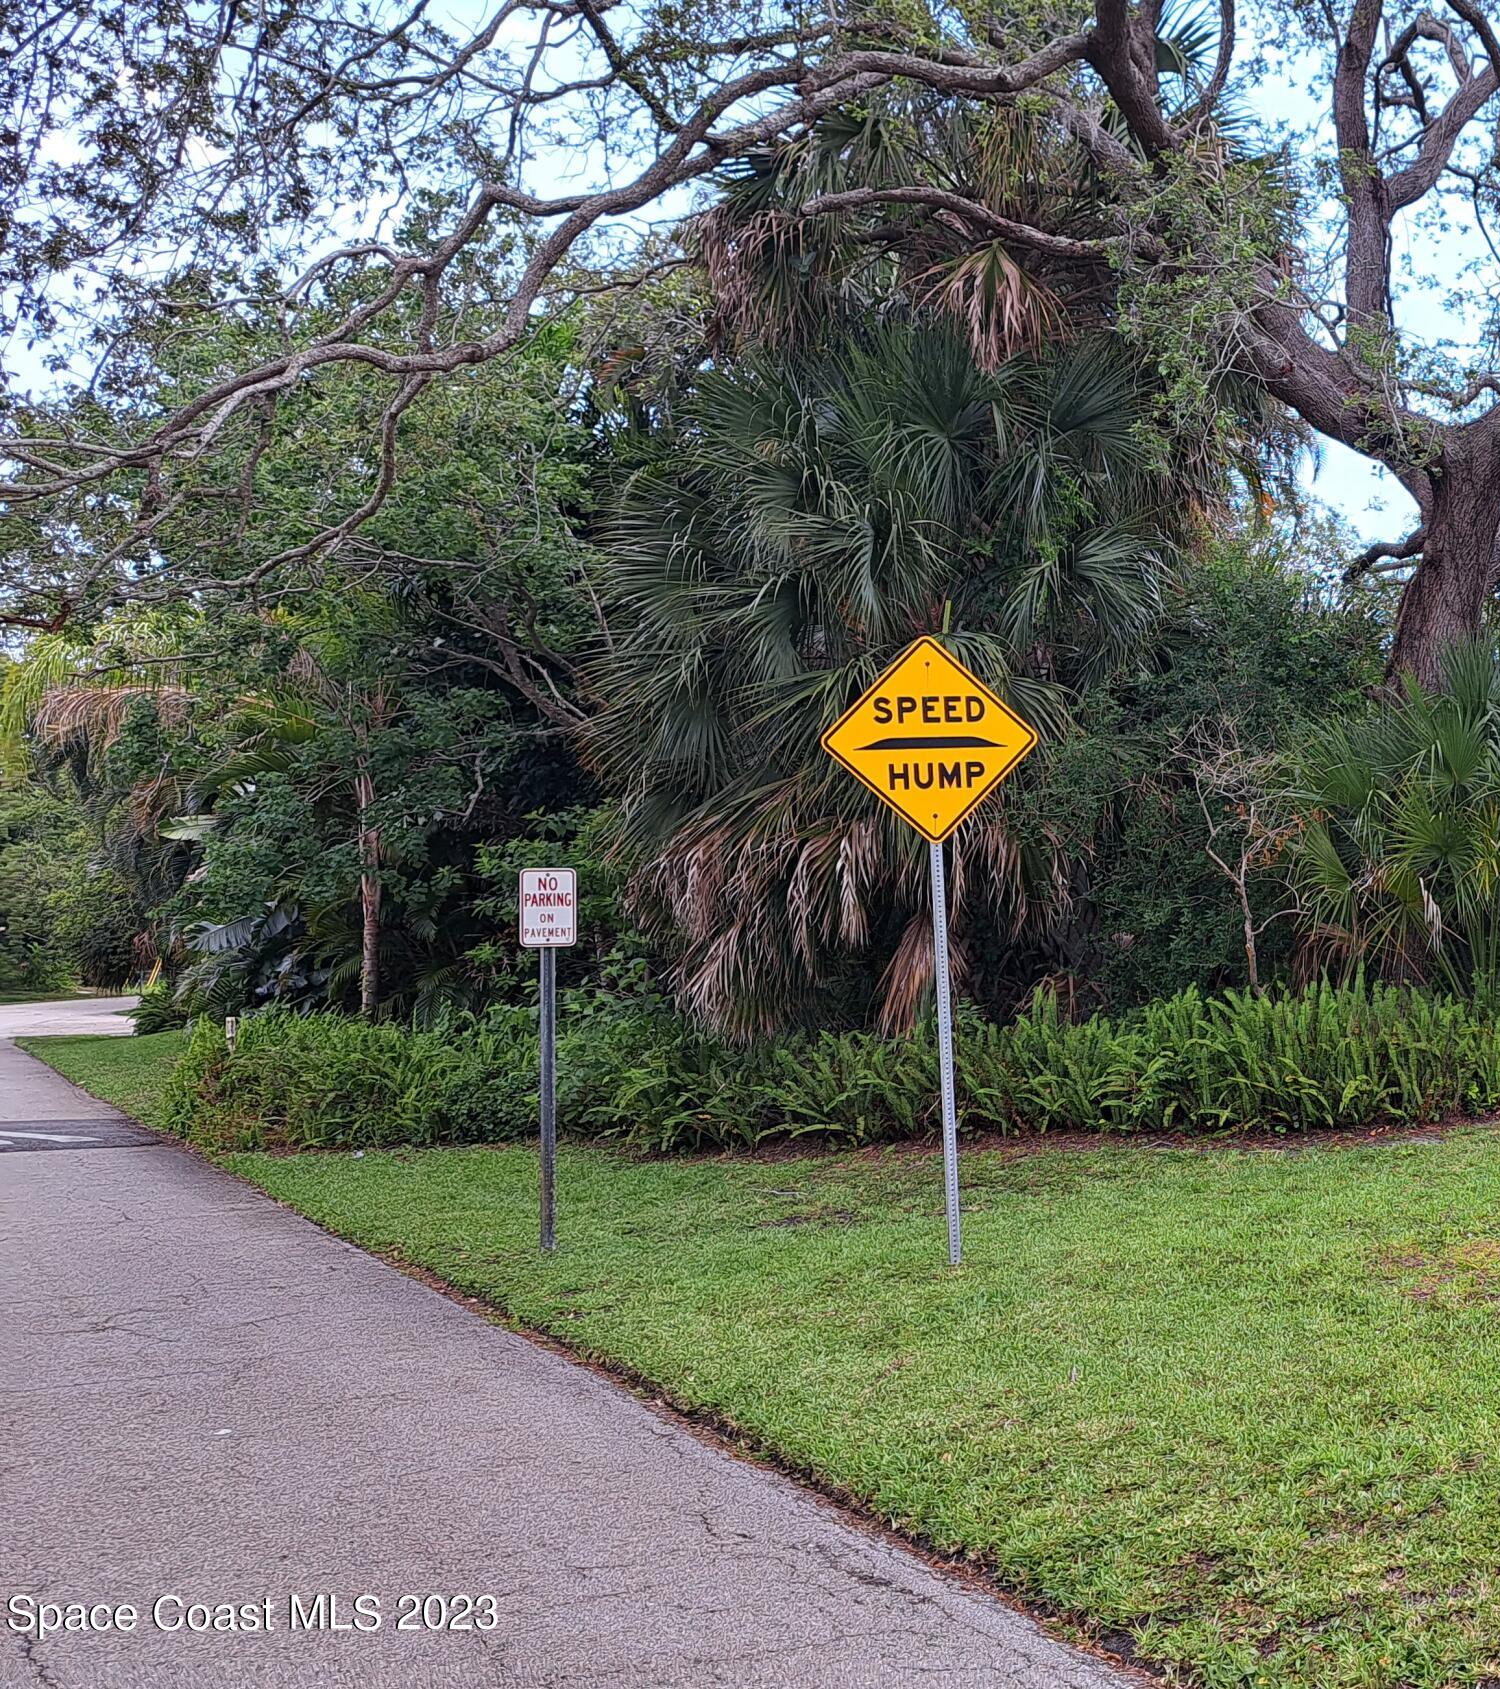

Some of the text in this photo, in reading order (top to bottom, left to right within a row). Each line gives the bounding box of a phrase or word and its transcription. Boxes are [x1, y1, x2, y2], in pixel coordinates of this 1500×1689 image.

[873, 696, 985, 724] SPEED
[888, 761, 985, 790] HUMP
[538, 877, 558, 891] NO
[524, 893, 572, 907] PARKING
[540, 913, 554, 923] ON
[524, 927, 571, 938] PAVEMENT
